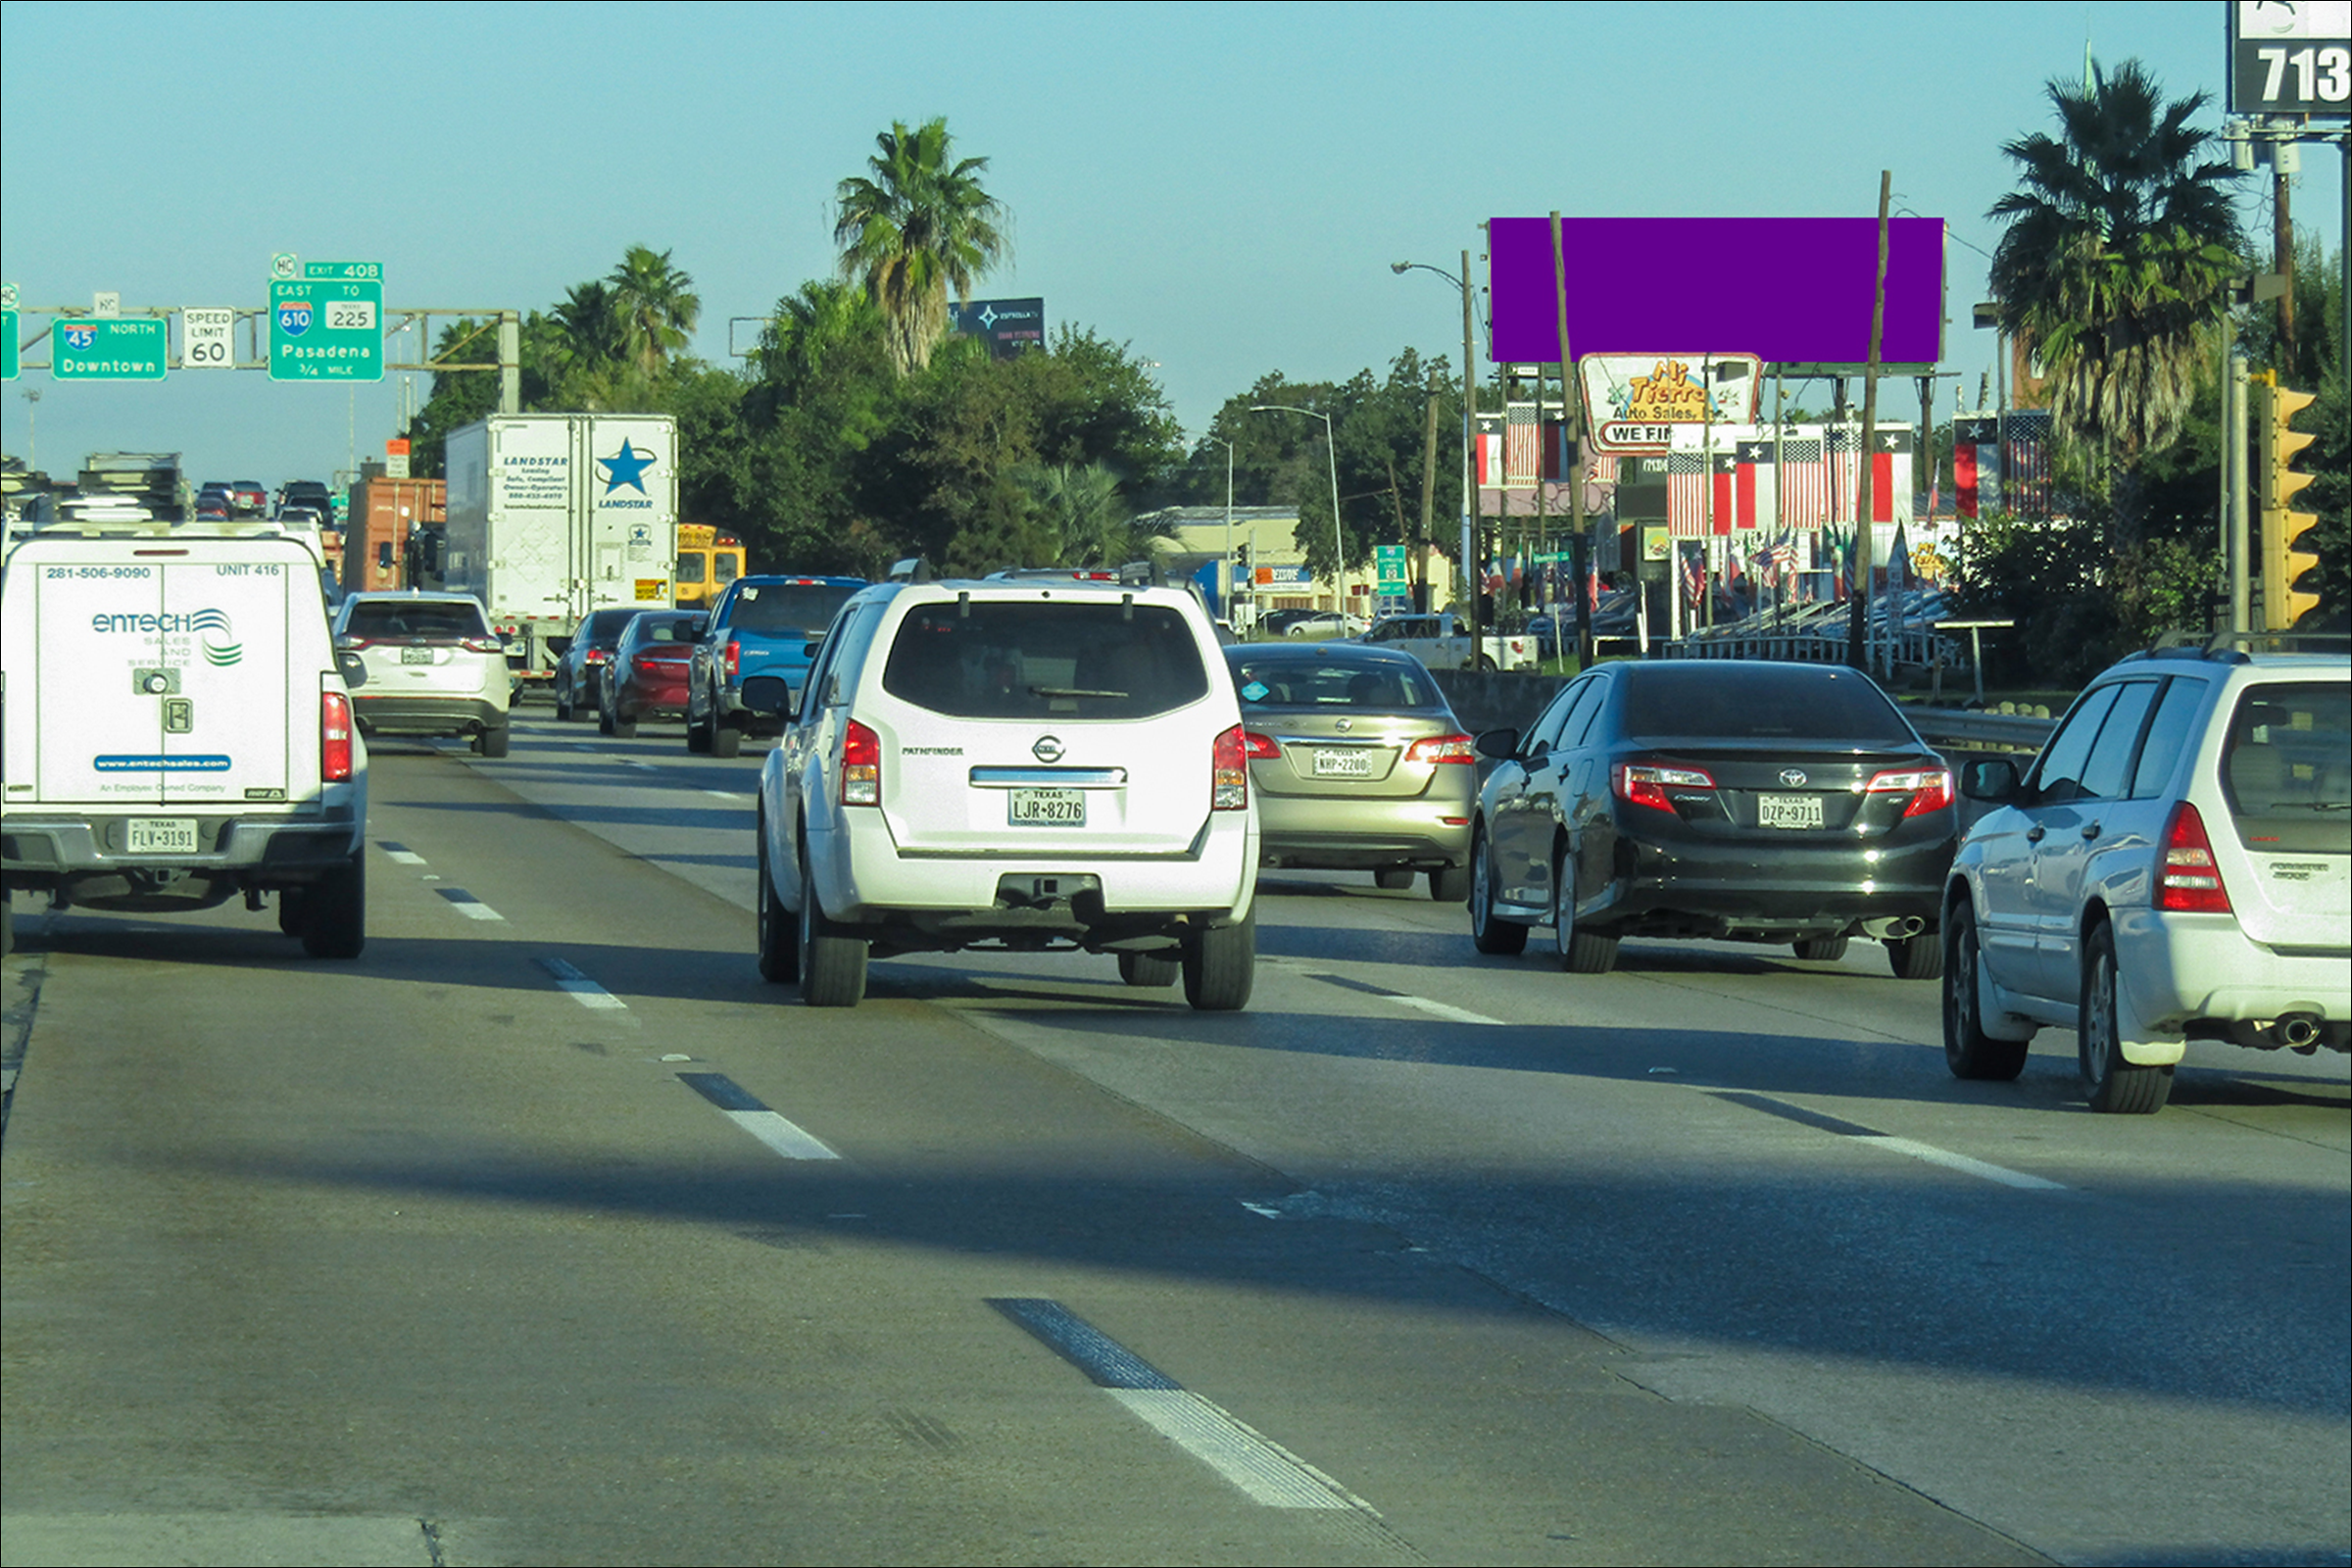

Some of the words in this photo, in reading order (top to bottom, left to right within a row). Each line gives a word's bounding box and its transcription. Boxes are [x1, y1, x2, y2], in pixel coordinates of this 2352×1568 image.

[2258, 48, 2350, 102] 713
[277, 261, 293, 272] HC
[309, 266, 334, 275] EXIT
[344, 264, 378, 277] 408
[276, 285, 313, 296] EAST
[343, 284, 361, 296] TO
[187, 314, 230, 325] SPEED
[281, 313, 310, 326] 610
[333, 312, 368, 327] 225
[110, 324, 156, 335] NORTH
[191, 327, 224, 338] LIMIT
[69, 330, 93, 347] 45
[191, 343, 225, 362] 60
[281, 345, 370, 359] Pasadena
[63, 359, 155, 372] Downtown
[327, 367, 354, 375] MILE
[1613, 407, 1646, 418] Auto
[1653, 407, 1696, 419] Sales,
[1613, 428, 1641, 440] WE
[504, 457, 568, 466] LANDSTAR
[599, 500, 653, 509] LANDSTAR
[47, 567, 151, 579] 281-506-9090
[217, 565, 250, 576] UNIT
[255, 565, 279, 575] 416
[144, 637, 191, 646] SALES
[161, 648, 191, 657] AND
[902, 747, 964, 756] PATHFINDER
[187, 784, 226, 794] Company
